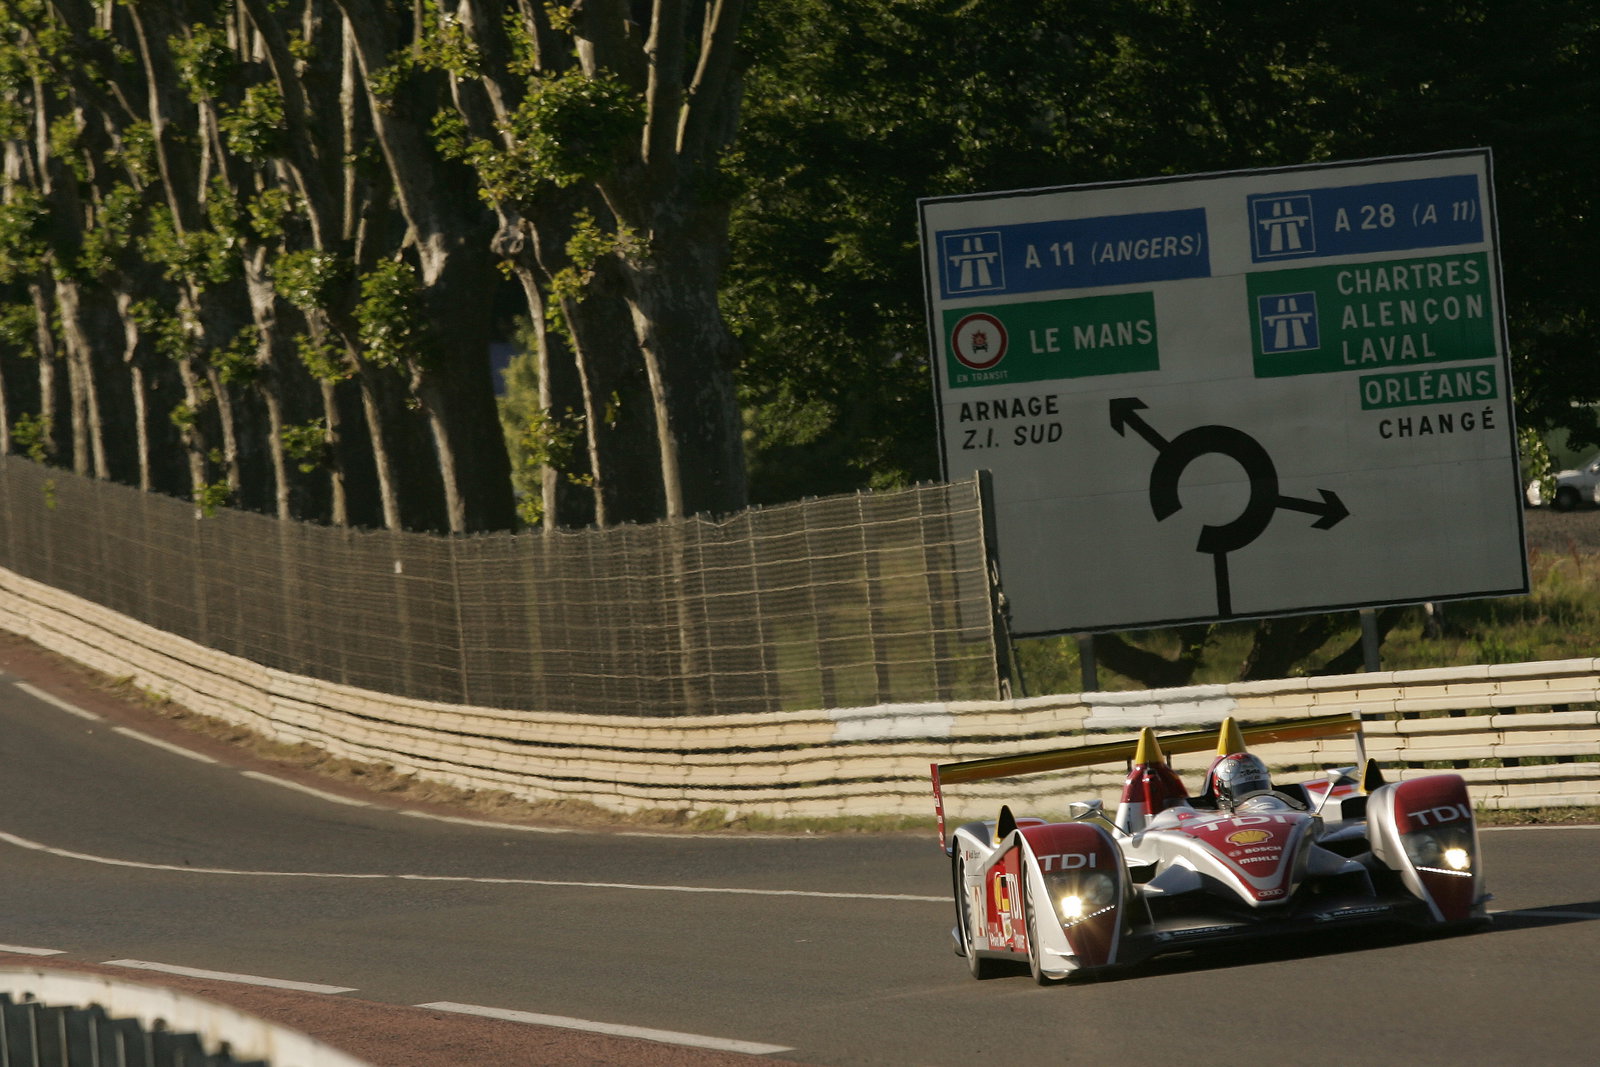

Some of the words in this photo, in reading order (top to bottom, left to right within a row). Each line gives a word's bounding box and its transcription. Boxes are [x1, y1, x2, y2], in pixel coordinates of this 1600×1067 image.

[1335, 208, 1350, 232] A
[1360, 203, 1396, 230] 28
[1412, 203, 1438, 227] (A
[1452, 199, 1476, 222] 11)
[1025, 244, 1041, 269] A
[1050, 241, 1075, 266] 11
[1091, 232, 1201, 266] (ANGERS)
[1336, 260, 1480, 295] CHARTRES
[1342, 294, 1483, 330] ALENÇON
[1030, 327, 1060, 354] LE
[1073, 319, 1153, 350] MANS
[1342, 333, 1436, 365] LAVAL
[957, 373, 969, 383] EN
[972, 370, 1009, 382] TRANSIT
[1364, 371, 1492, 405] ORLÉANS
[959, 395, 1059, 423] ARNAGE
[1379, 406, 1495, 439] CHANGÉ
[962, 428, 999, 450] Z.I.
[1014, 422, 1063, 446] SUD
[1193, 815, 1287, 831] TDI
[1408, 803, 1472, 826] TDI
[1038, 852, 1097, 871] TDI
[1239, 855, 1279, 865] MAHLE
[1245, 846, 1281, 854] BOSCH
